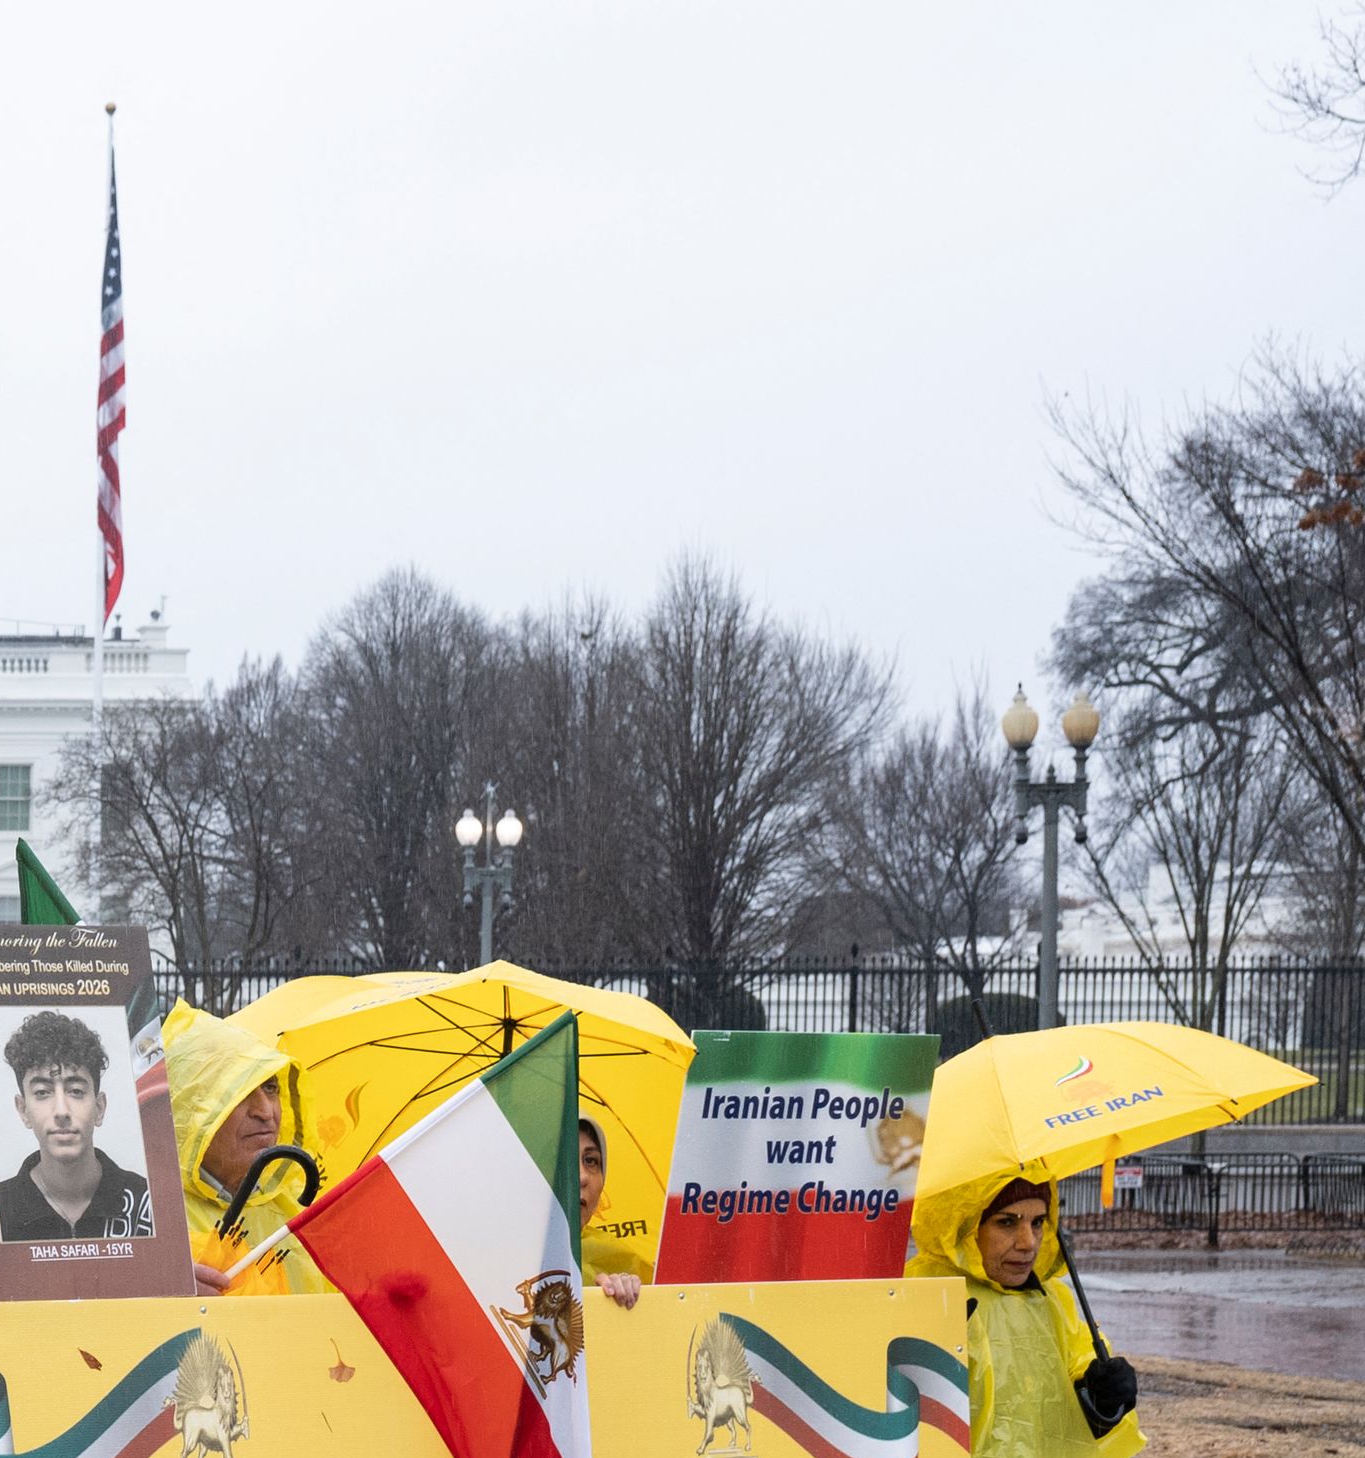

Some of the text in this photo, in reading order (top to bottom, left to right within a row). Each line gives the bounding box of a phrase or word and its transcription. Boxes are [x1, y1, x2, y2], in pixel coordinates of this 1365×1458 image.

[45, 932, 66, 948] the
[69, 926, 118, 948] Fallen
[31, 959, 63, 973] Those
[67, 959, 94, 973] Killed
[96, 960, 129, 975] During
[13, 982, 76, 996] UPRISINGS
[77, 979, 111, 996] 2026
[701, 1086, 904, 1127] Iranian People
[1044, 1086, 1163, 1128] FREE IRAN
[766, 1135, 836, 1163] want
[681, 1181, 899, 1223] Regime Change
[30, 1242, 133, 1258] TAHA SAFARI -15YR
